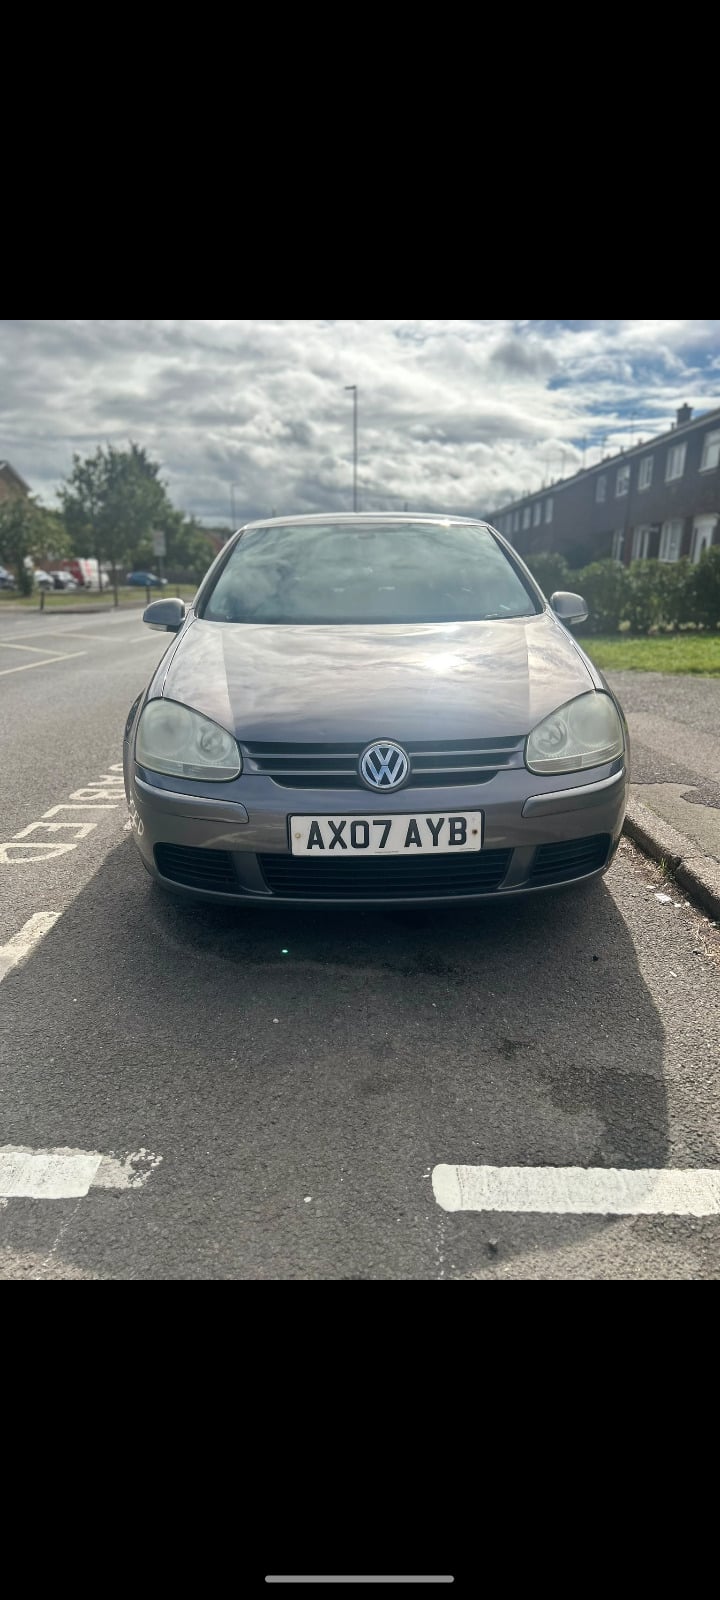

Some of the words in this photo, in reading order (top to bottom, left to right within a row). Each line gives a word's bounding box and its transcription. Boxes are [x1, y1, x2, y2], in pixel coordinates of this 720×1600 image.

[362, 743, 408, 788] VW
[0, 763, 126, 863] ABLED
[306, 820, 392, 850] AX07
[404, 816, 467, 848] AYB
